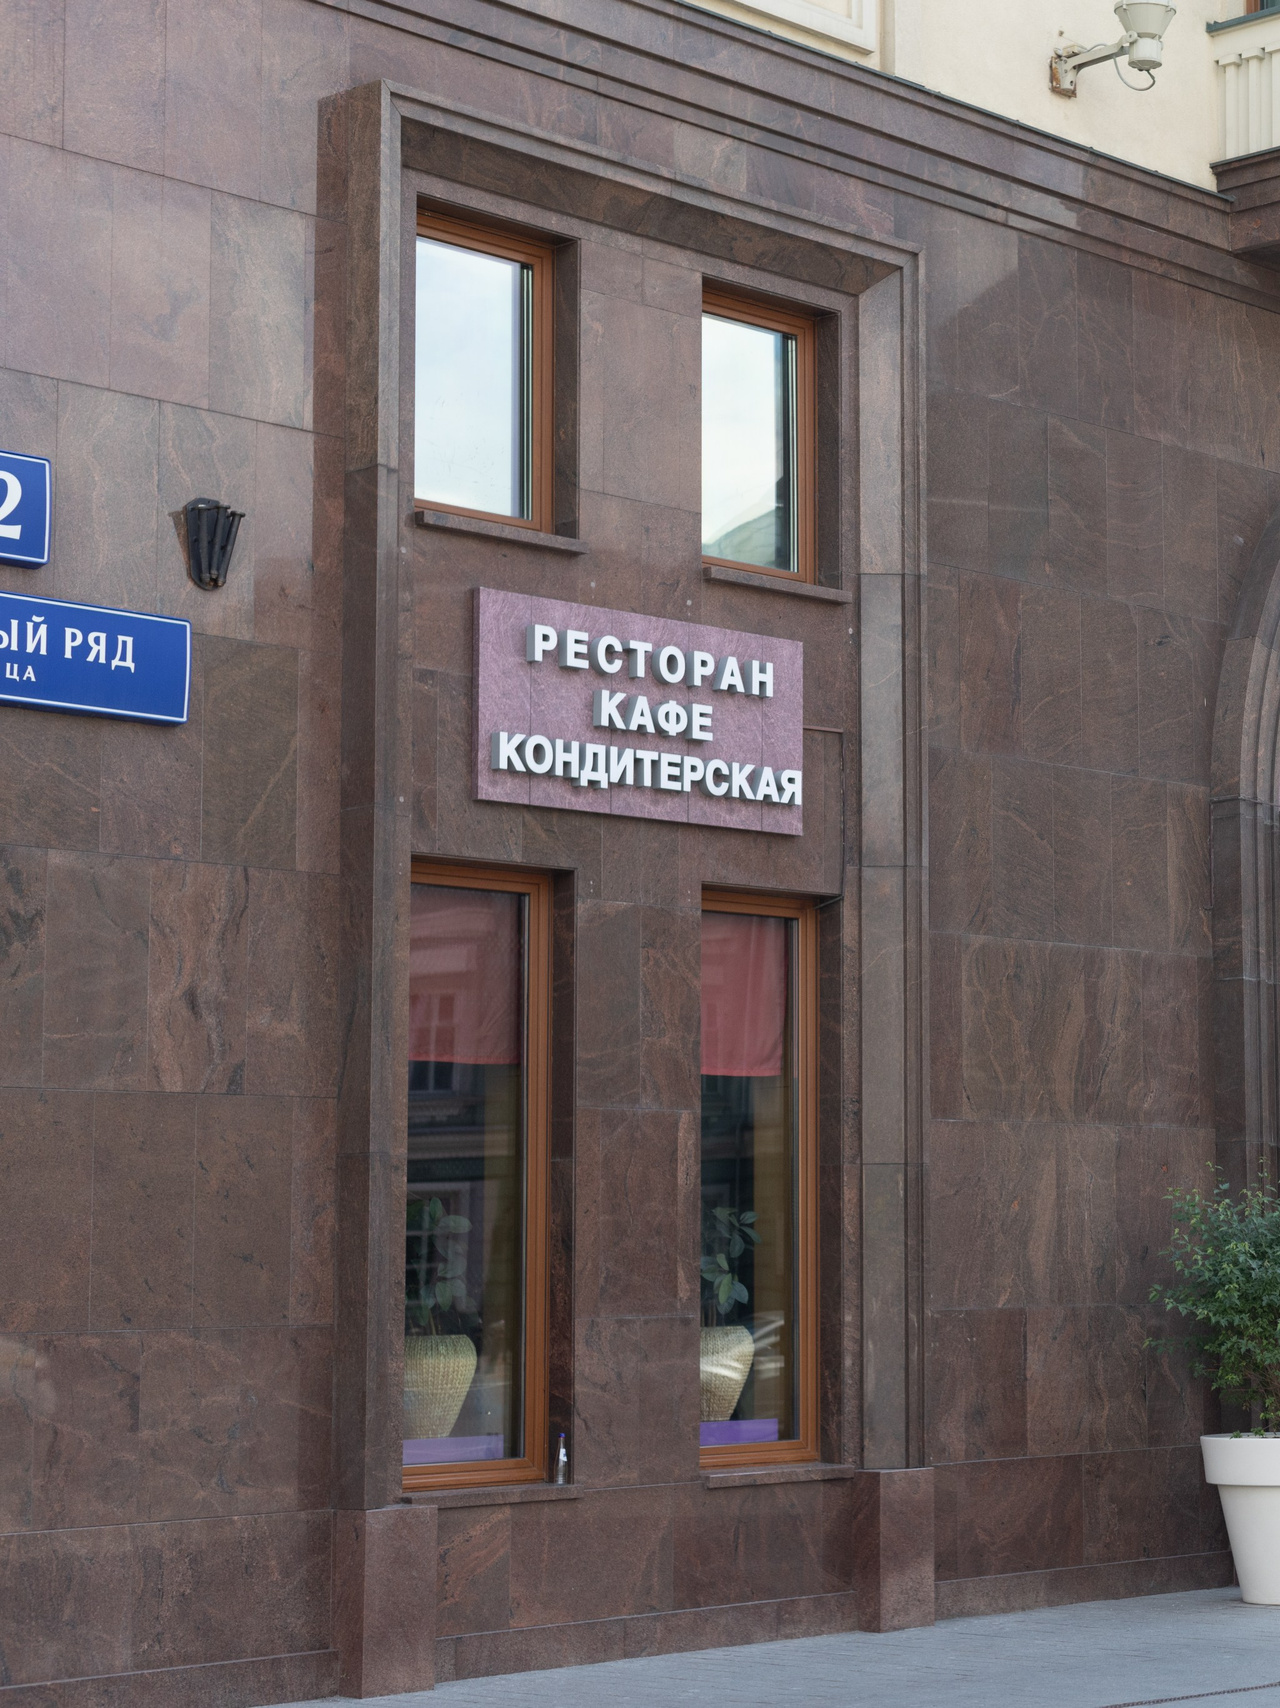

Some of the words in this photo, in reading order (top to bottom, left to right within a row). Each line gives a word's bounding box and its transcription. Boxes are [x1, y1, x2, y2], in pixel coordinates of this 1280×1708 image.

[64, 626, 136, 674] РЯД
[533, 623, 774, 698] РЕСТОРАН
[600, 689, 714, 742] КАФЕ
[499, 731, 802, 806] КОНДИТЕРСКАЯ
